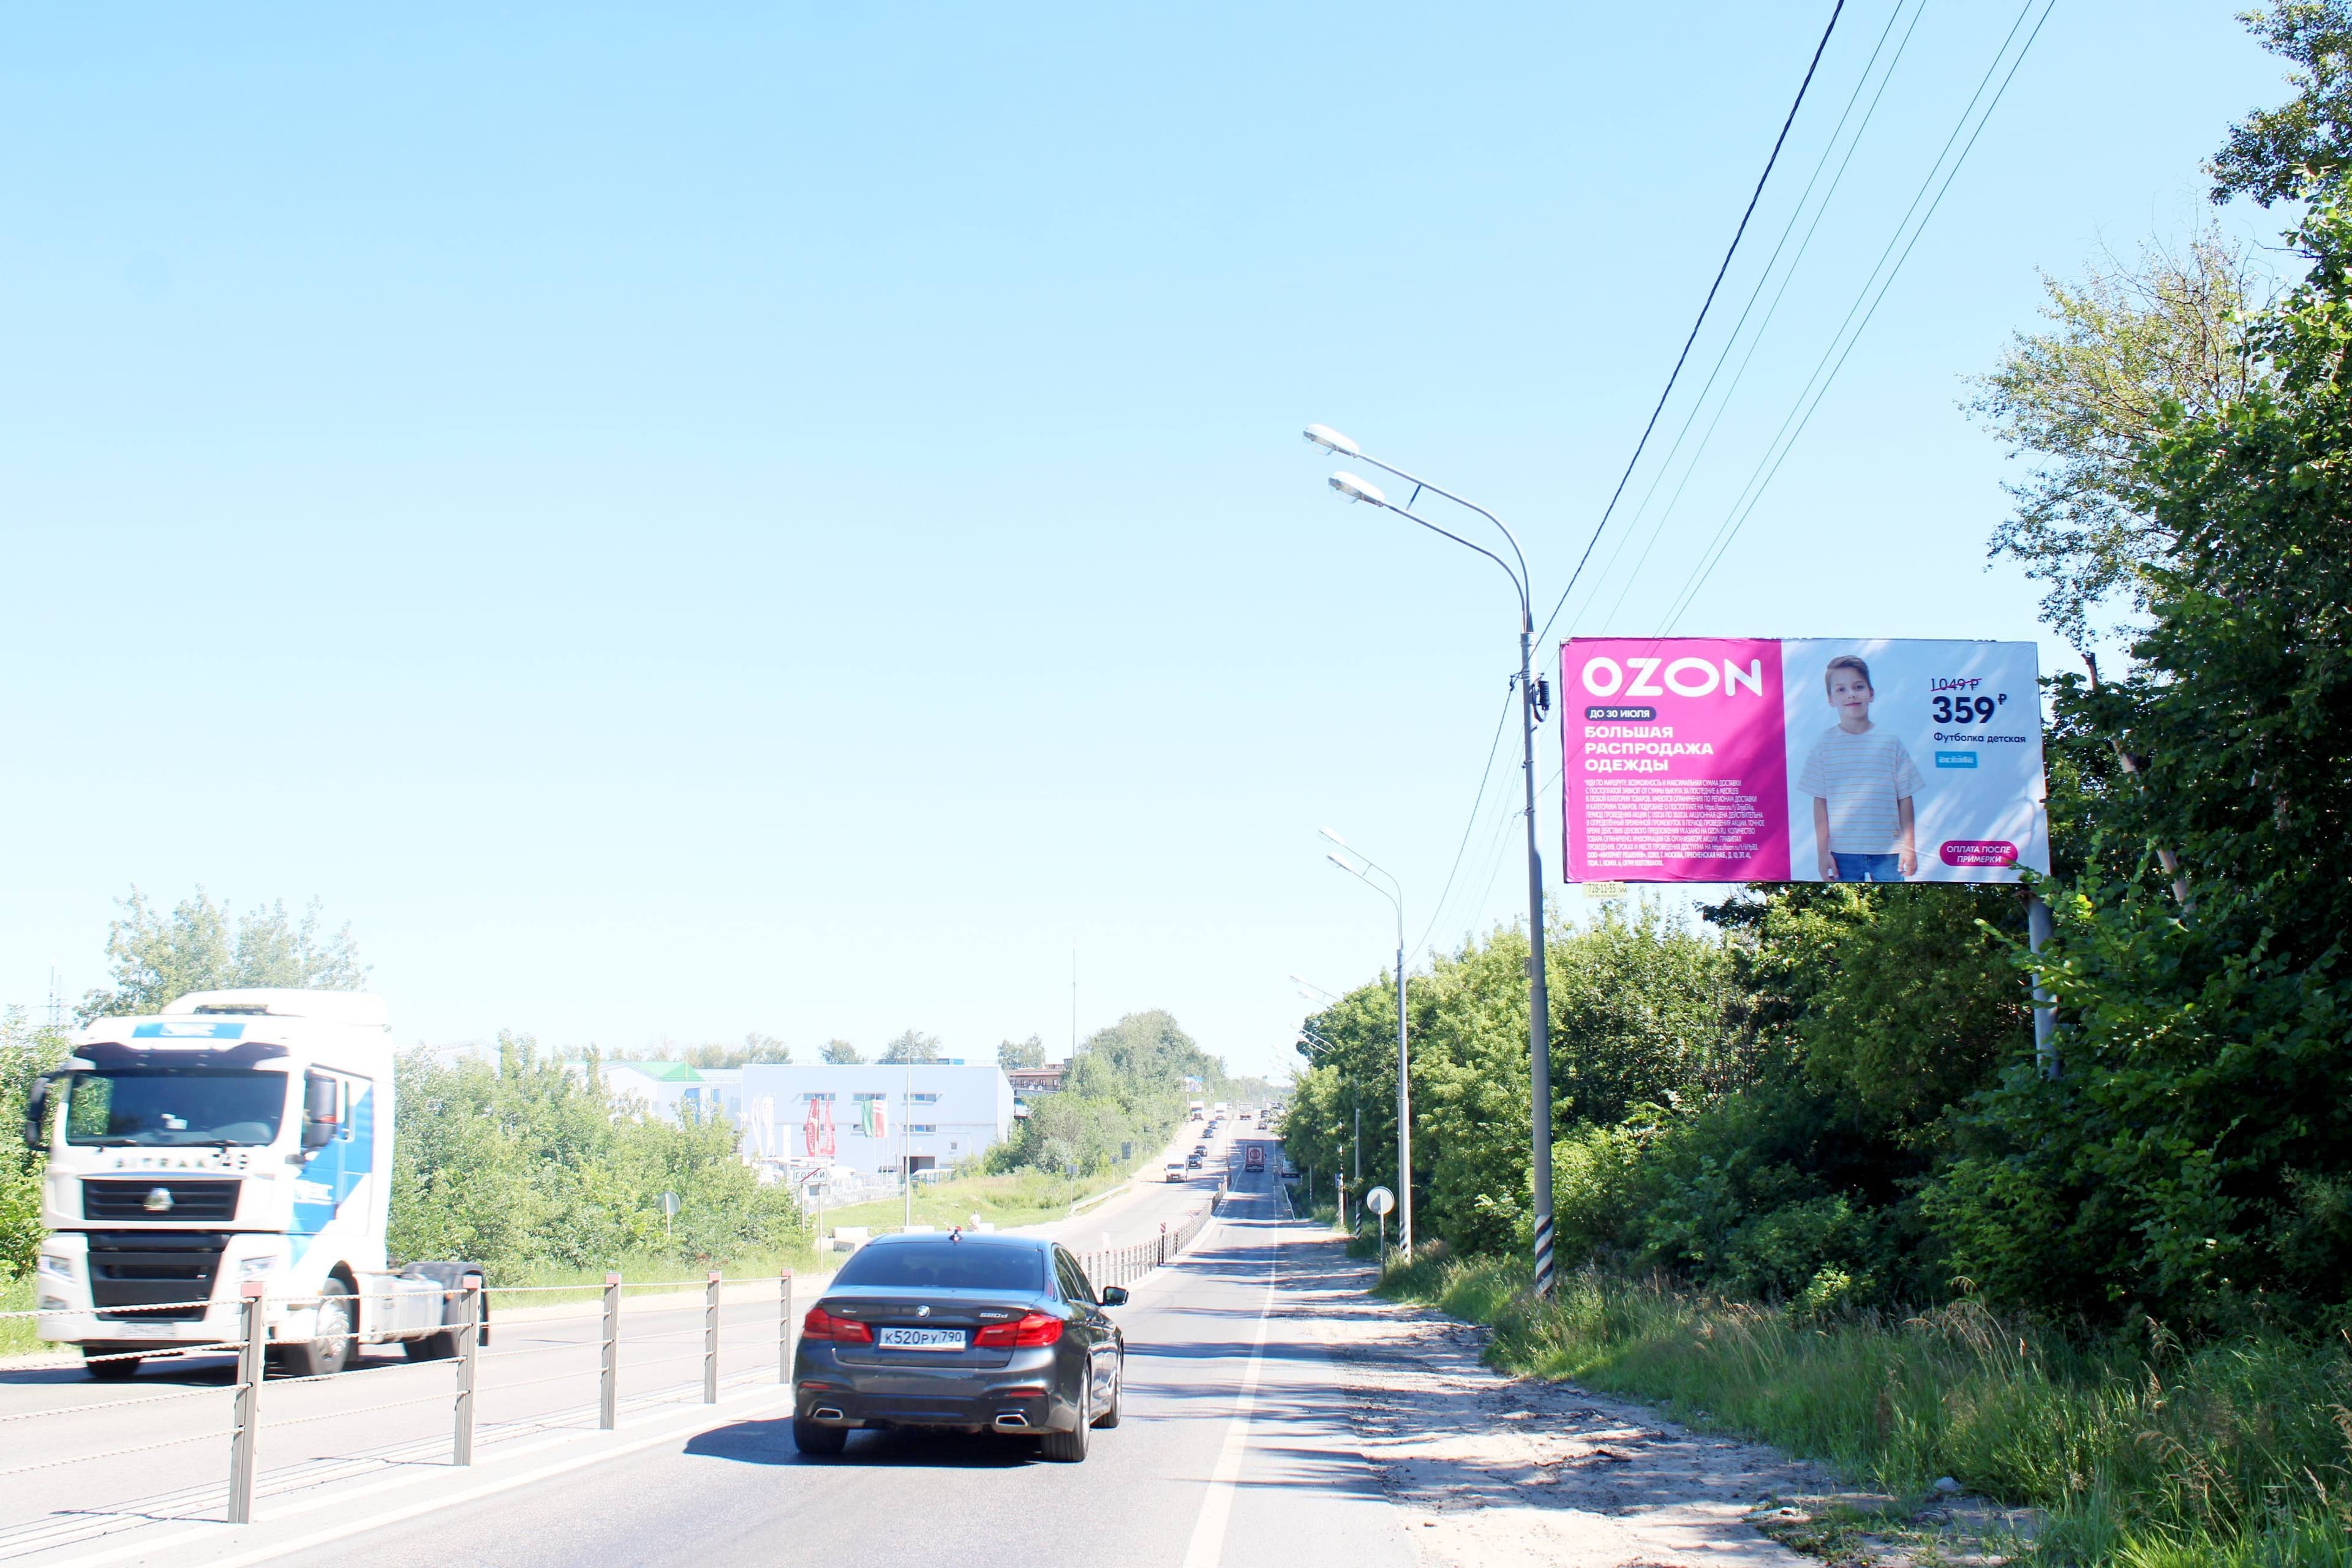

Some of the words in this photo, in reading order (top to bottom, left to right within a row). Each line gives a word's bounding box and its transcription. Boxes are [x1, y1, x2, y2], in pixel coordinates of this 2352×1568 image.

[1582, 657, 1762, 697] OZON
[1589, 709, 1604, 719] ДО
[1606, 709, 1618, 718] 30
[1620, 709, 1650, 718] ИЮЛЯ
[1932, 696, 1995, 724] 359
[1585, 726, 1673, 738] БОЛЬШАЯ
[1934, 733, 1984, 744] Футболка
[1987, 735, 2026, 744] детская
[1585, 742, 1714, 756] РАСПРОДАЖА
[1585, 759, 1668, 773] ОДЕЖДЫ
[941, 1332, 962, 1342] 790
